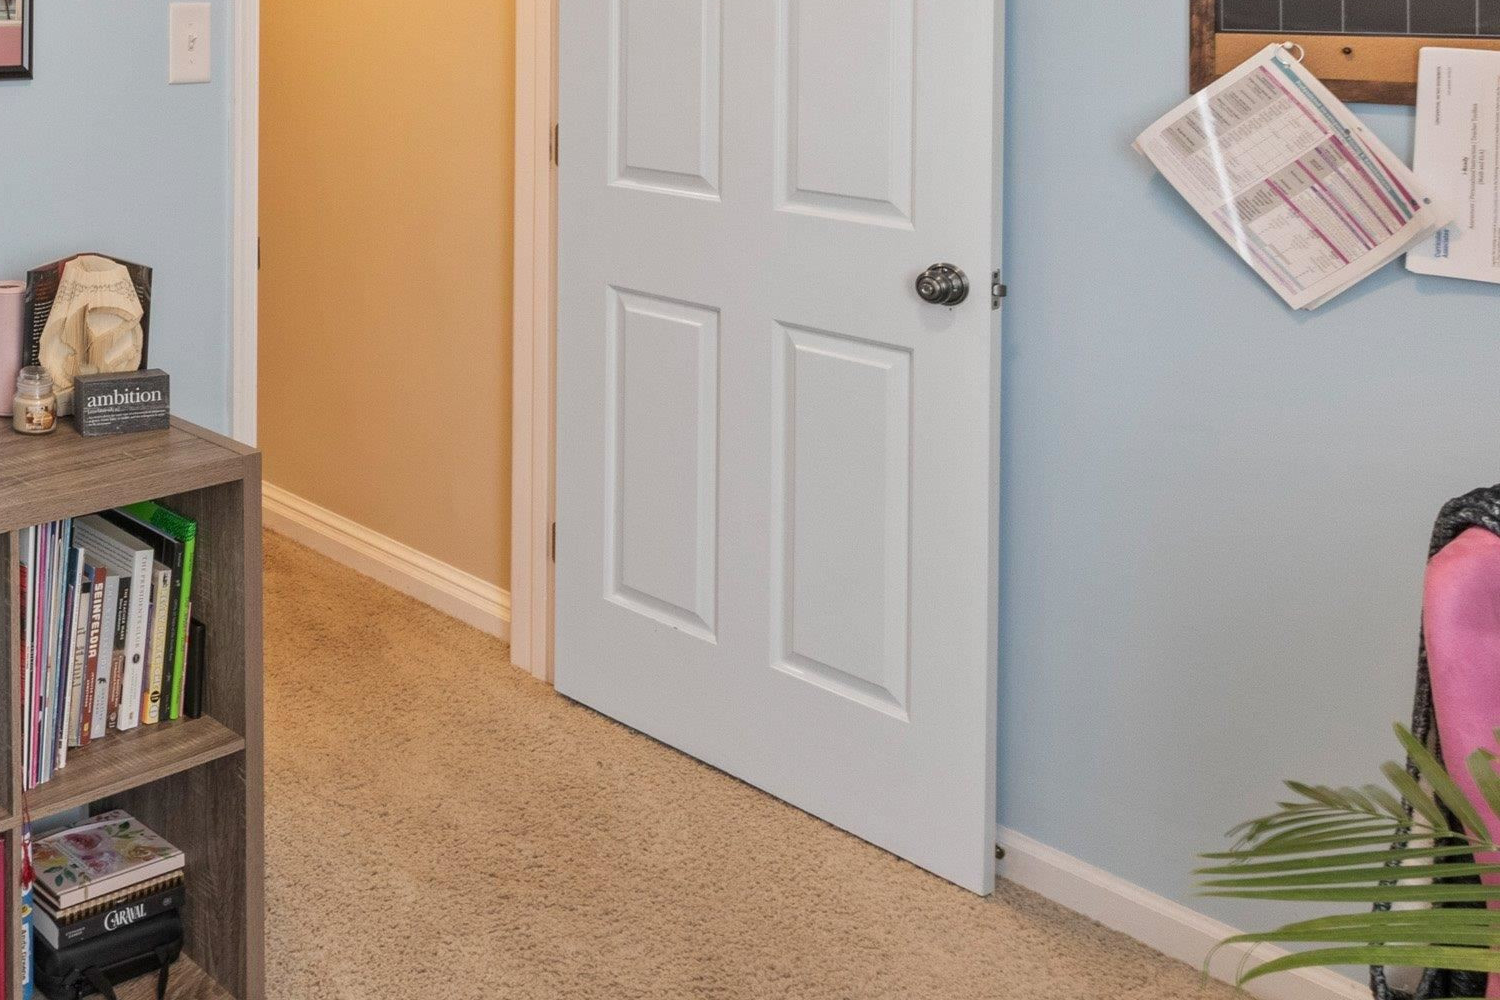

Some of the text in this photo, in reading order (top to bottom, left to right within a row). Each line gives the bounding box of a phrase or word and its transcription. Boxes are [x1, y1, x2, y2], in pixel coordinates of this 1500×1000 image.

[87, 387, 162, 407] ambition
[137, 574, 145, 625] PRESIDENTS
[88, 582, 103, 658] SEINFELDIA
[103, 903, 147, 932] CARAVAL
